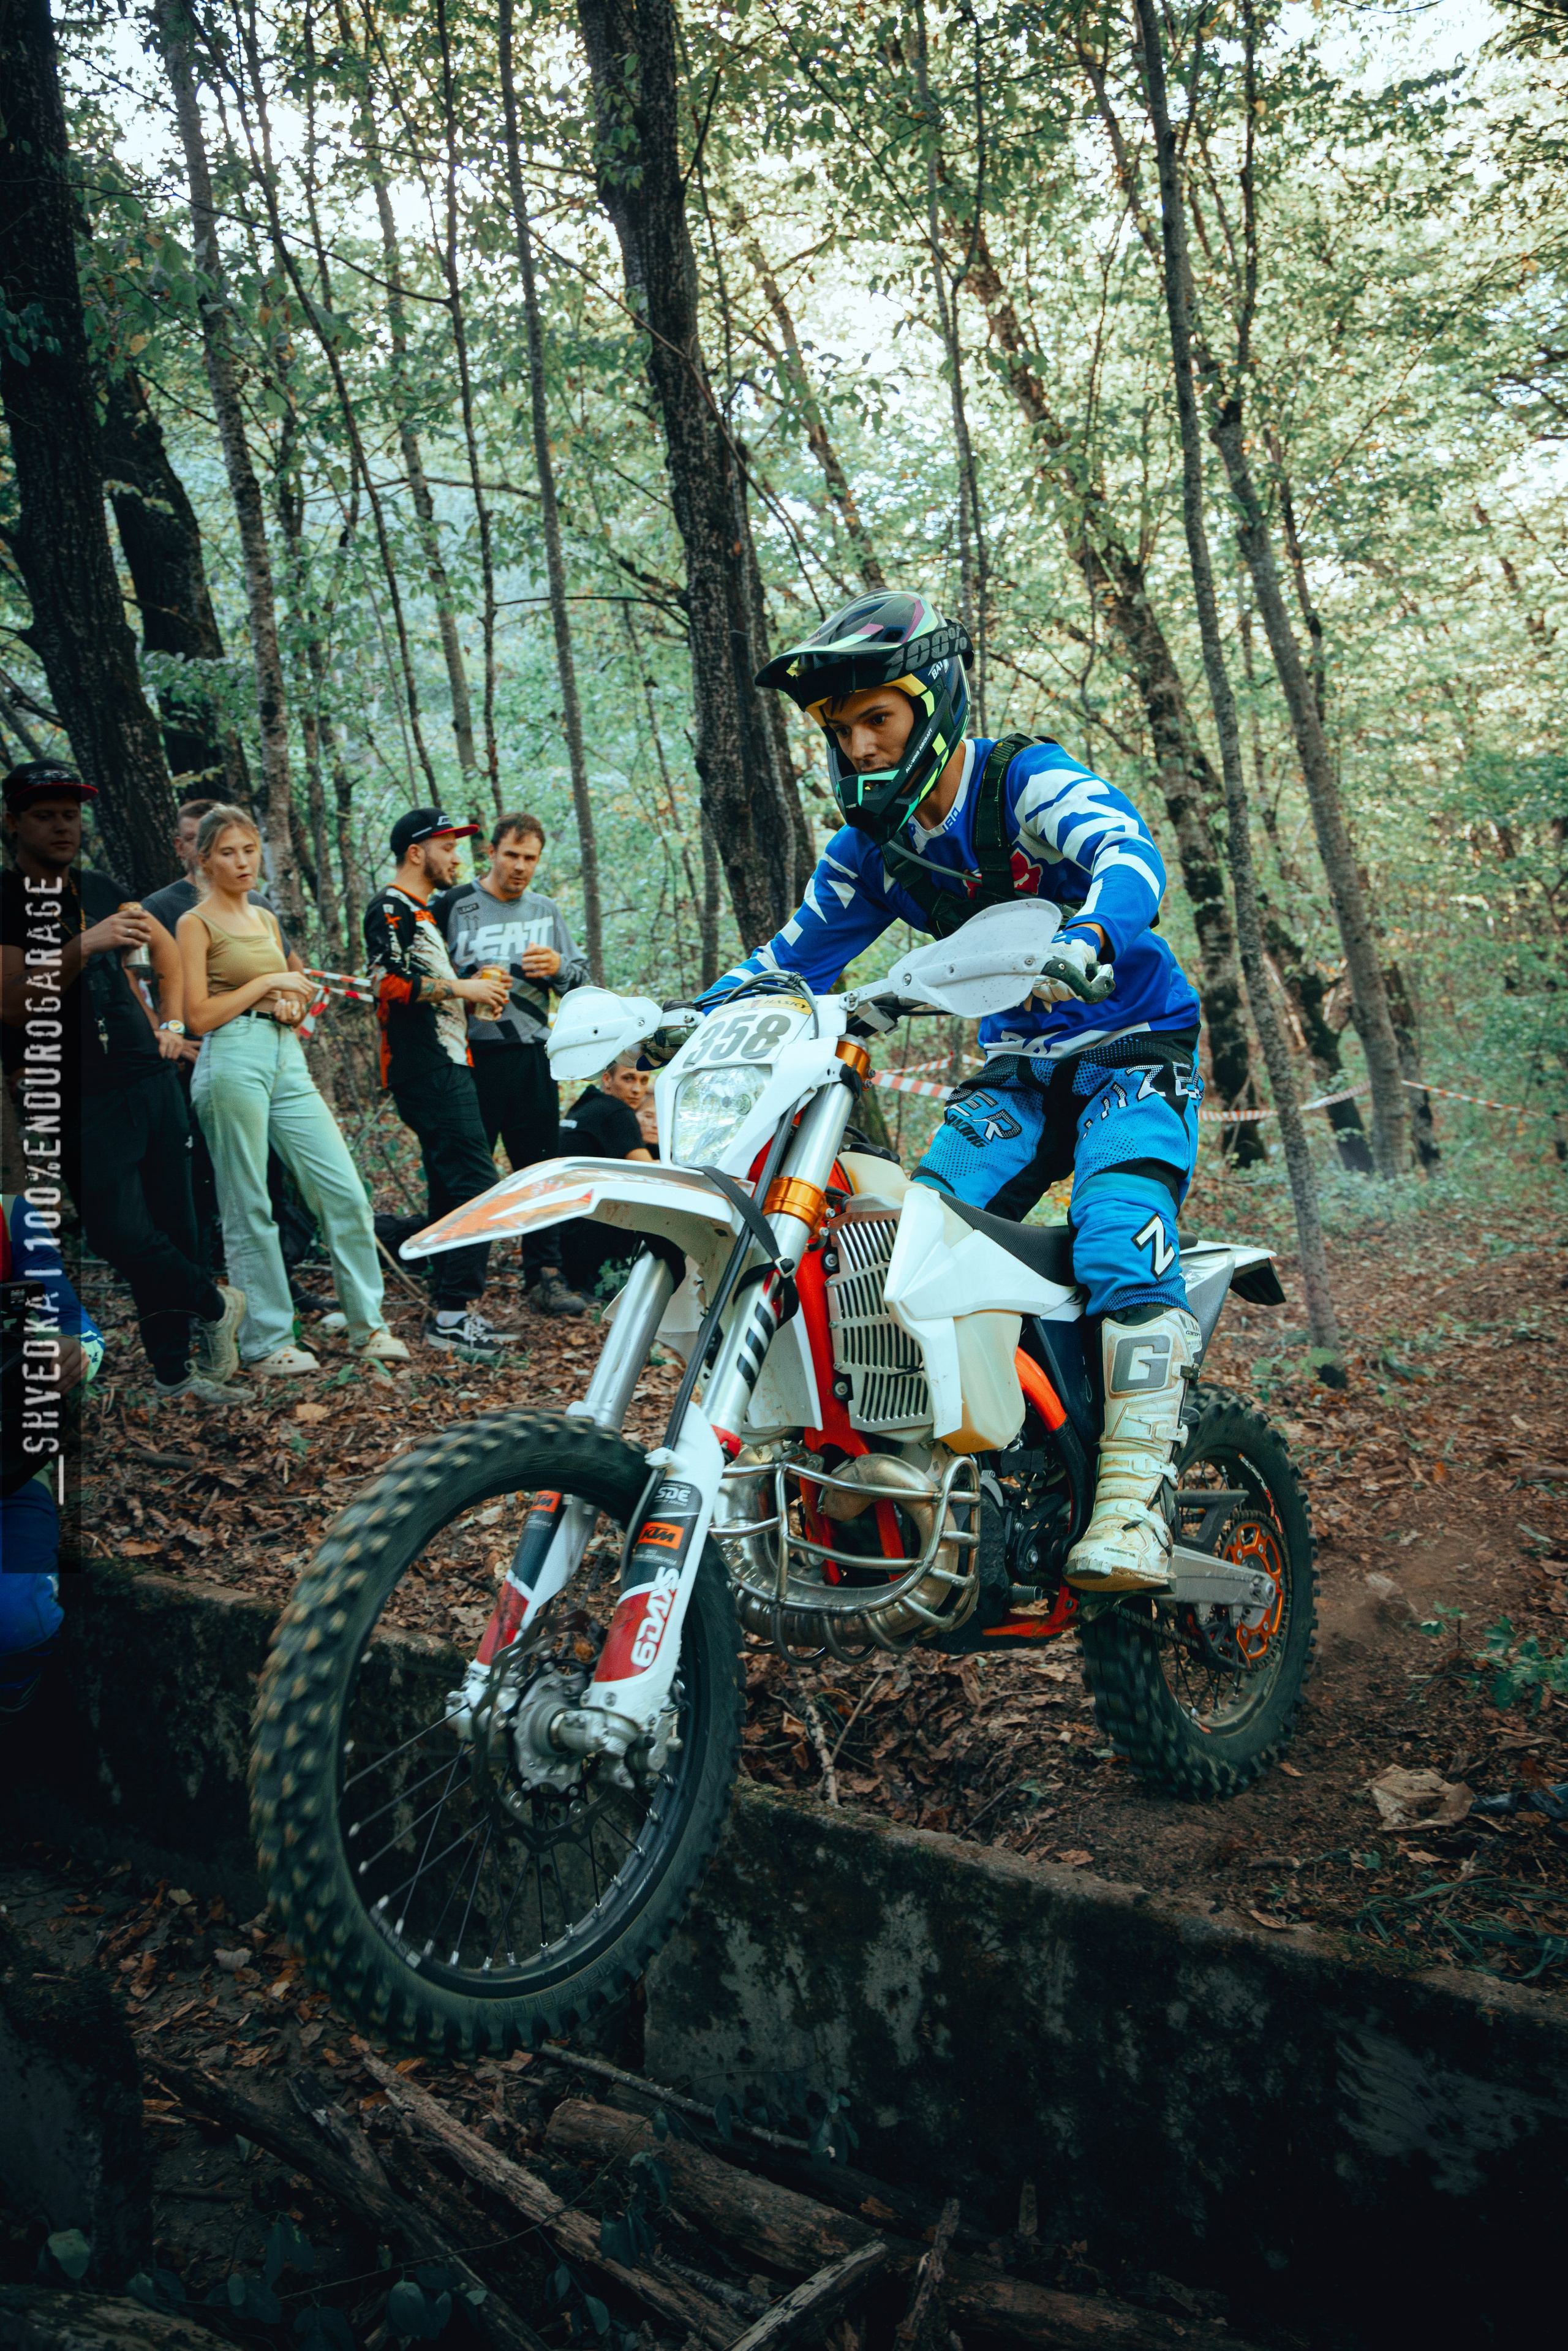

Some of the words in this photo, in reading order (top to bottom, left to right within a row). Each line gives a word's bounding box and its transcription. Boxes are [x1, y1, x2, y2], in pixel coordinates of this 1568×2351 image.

[883, 625, 967, 682] 100%
[919, 728, 933, 751] AIRCRAFT
[682, 1014, 791, 1069] 358
[1110, 1335, 1171, 1393] G
[534, 1494, 554, 1507] TM
[641, 1526, 676, 1542] KTM
